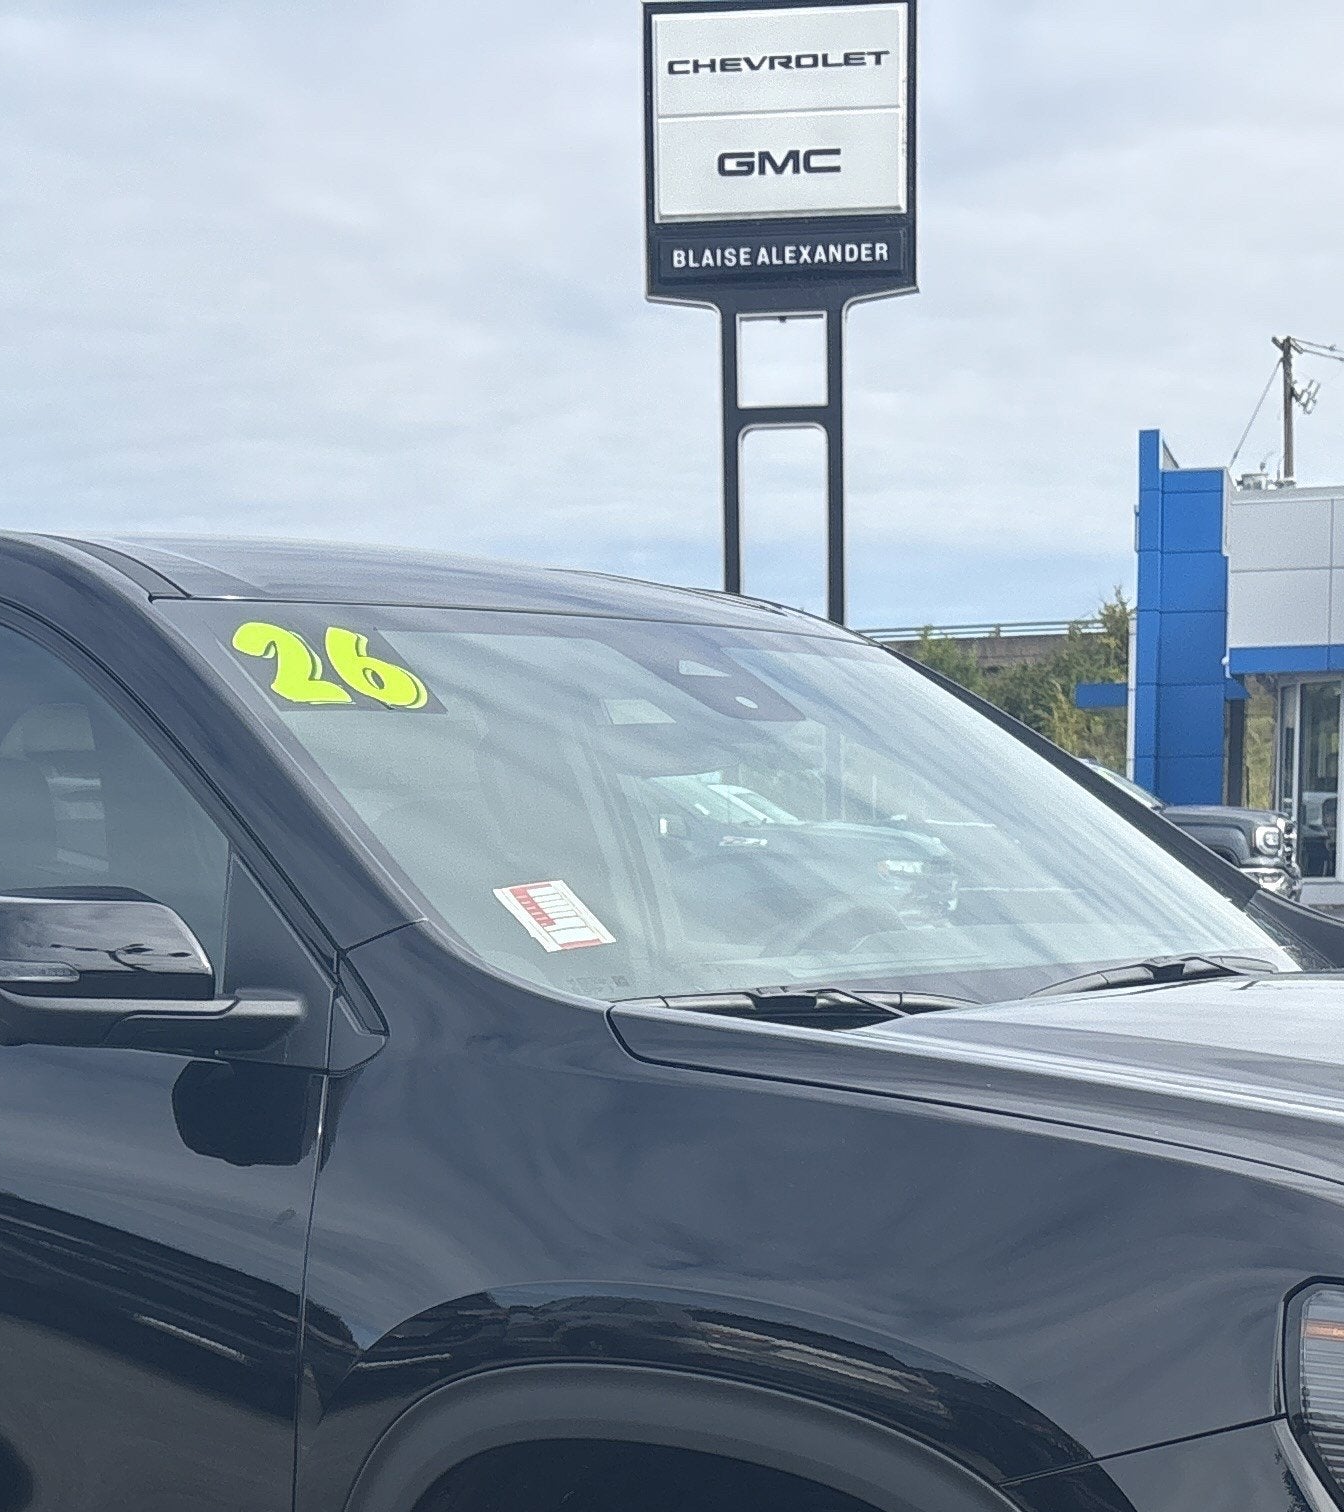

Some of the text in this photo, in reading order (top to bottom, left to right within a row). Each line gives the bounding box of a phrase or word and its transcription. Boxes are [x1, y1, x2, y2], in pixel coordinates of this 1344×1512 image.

[667, 50, 890, 75] CHEVROLET
[717, 148, 842, 177] GMC
[672, 242, 889, 269] BLAISE ALEXANDER
[232, 621, 428, 709] 26
